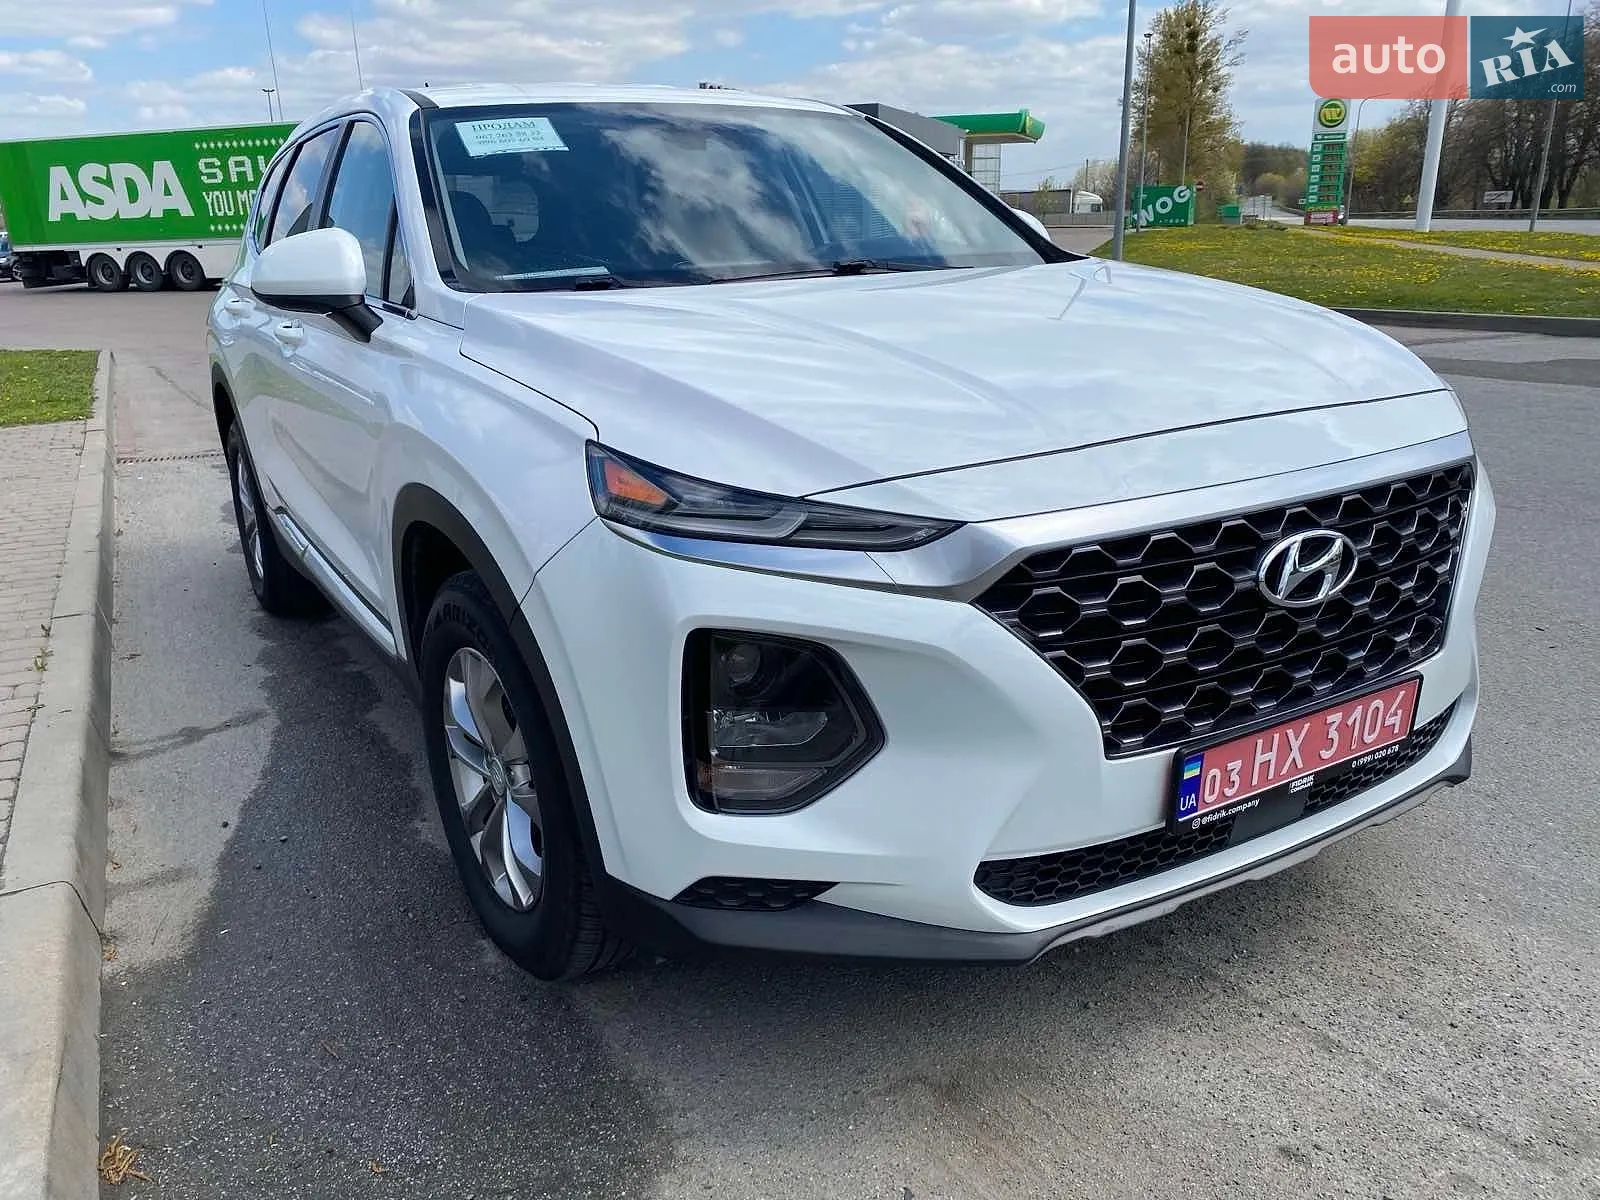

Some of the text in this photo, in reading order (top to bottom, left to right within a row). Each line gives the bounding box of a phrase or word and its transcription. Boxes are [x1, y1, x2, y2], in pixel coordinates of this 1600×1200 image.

[472, 121, 536, 132] ПРОДАМ
[48, 160, 195, 222] ASDA
[202, 190, 235, 216] YOU
[1132, 185, 1191, 226] WOG
[1204, 690, 1406, 803] 03 HX 3104
[1180, 793, 1197, 811] UA
